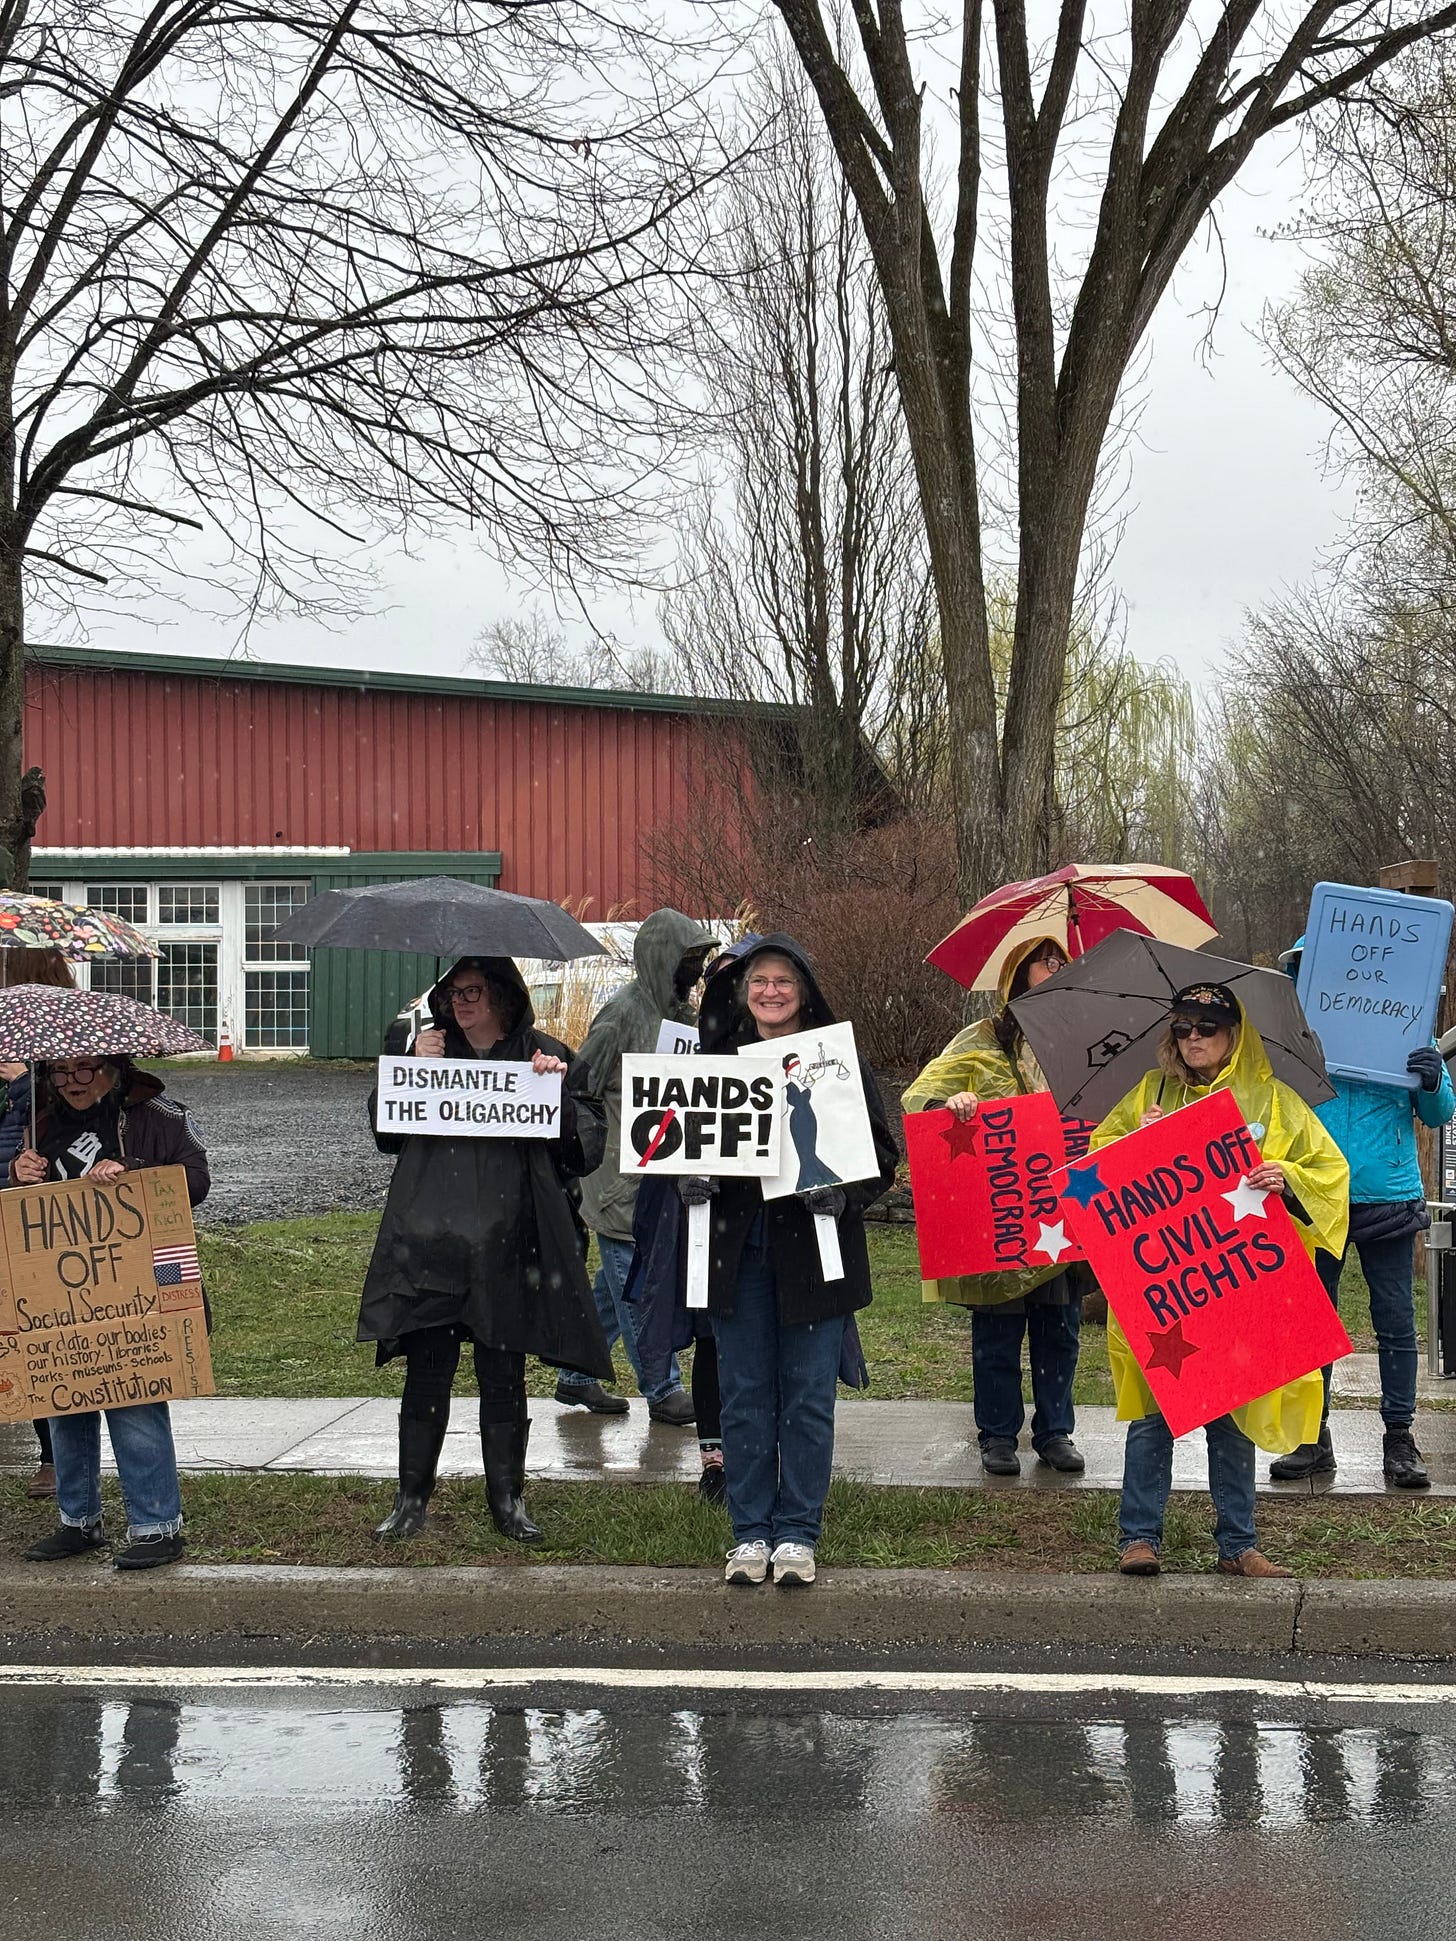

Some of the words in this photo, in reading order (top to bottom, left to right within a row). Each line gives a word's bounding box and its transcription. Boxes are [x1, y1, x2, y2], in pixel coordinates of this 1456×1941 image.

[1330, 907, 1421, 943] HANDS
[1351, 944, 1395, 962] OFF
[1345, 968, 1388, 984] OUR
[1319, 991, 1423, 1035] DEMOCRACY
[393, 1066, 518, 1093] DISMANTLE
[631, 1076, 774, 1111] HANDS
[385, 1100, 428, 1122] THE
[439, 1100, 559, 1125] OLIGARCHY
[630, 1109, 773, 1164] OFF!
[981, 1107, 1030, 1266] DEMOCRACY
[1025, 1152, 1058, 1219] OUR
[1095, 1154, 1205, 1237] HANDS
[1205, 1126, 1254, 1180] OFF
[20, 1183, 145, 1253] HANDS
[1133, 1206, 1240, 1275] CIVIL
[57, 1242, 122, 1288] OFF
[1144, 1232, 1286, 1327] RIGHTS
[17, 1290, 77, 1332] Social
[79, 1285, 157, 1326] Security
[162, 1287, 200, 1302] DISTRESS
[26, 1340, 53, 1356] our
[96, 1329, 122, 1347] our
[27, 1358, 51, 1371] our
[107, 1342, 160, 1361] libraries
[130, 1351, 173, 1368] schools
